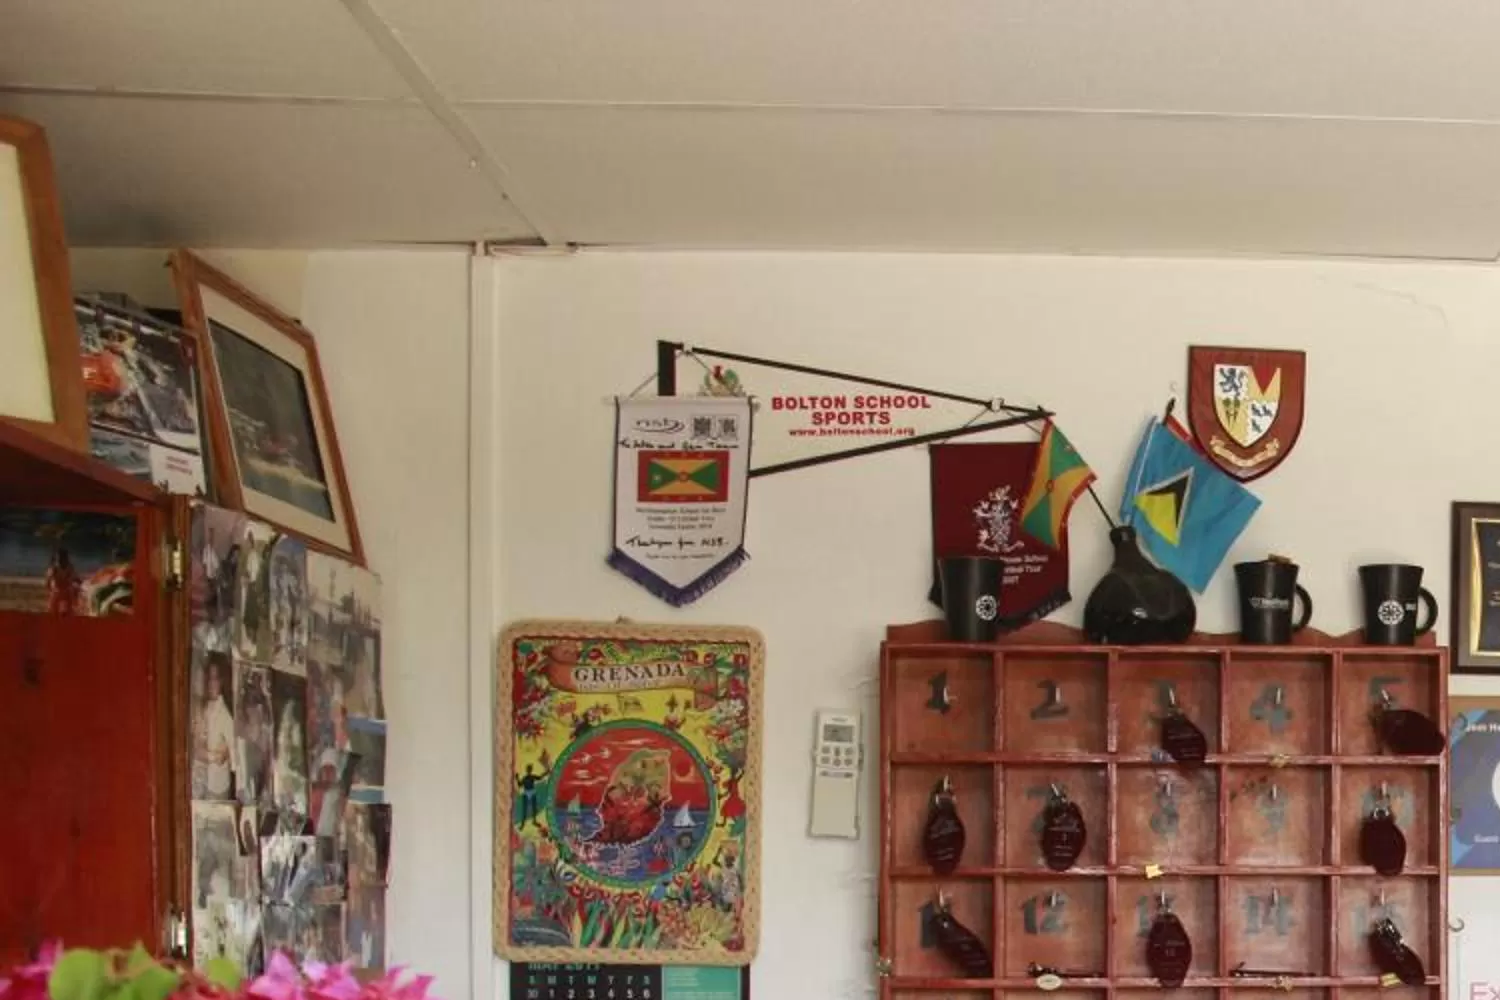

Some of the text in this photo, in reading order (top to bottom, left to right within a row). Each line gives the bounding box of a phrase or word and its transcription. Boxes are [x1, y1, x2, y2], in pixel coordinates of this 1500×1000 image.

[771, 395, 931, 410] BOLTON SCHOOL
[811, 411, 891, 425] SPORTS
[575, 663, 685, 682] GRENADA
[926, 670, 954, 715] 1
[1031, 679, 1070, 720] 2
[1249, 684, 1294, 730] 4
[1023, 890, 1071, 935] 12
